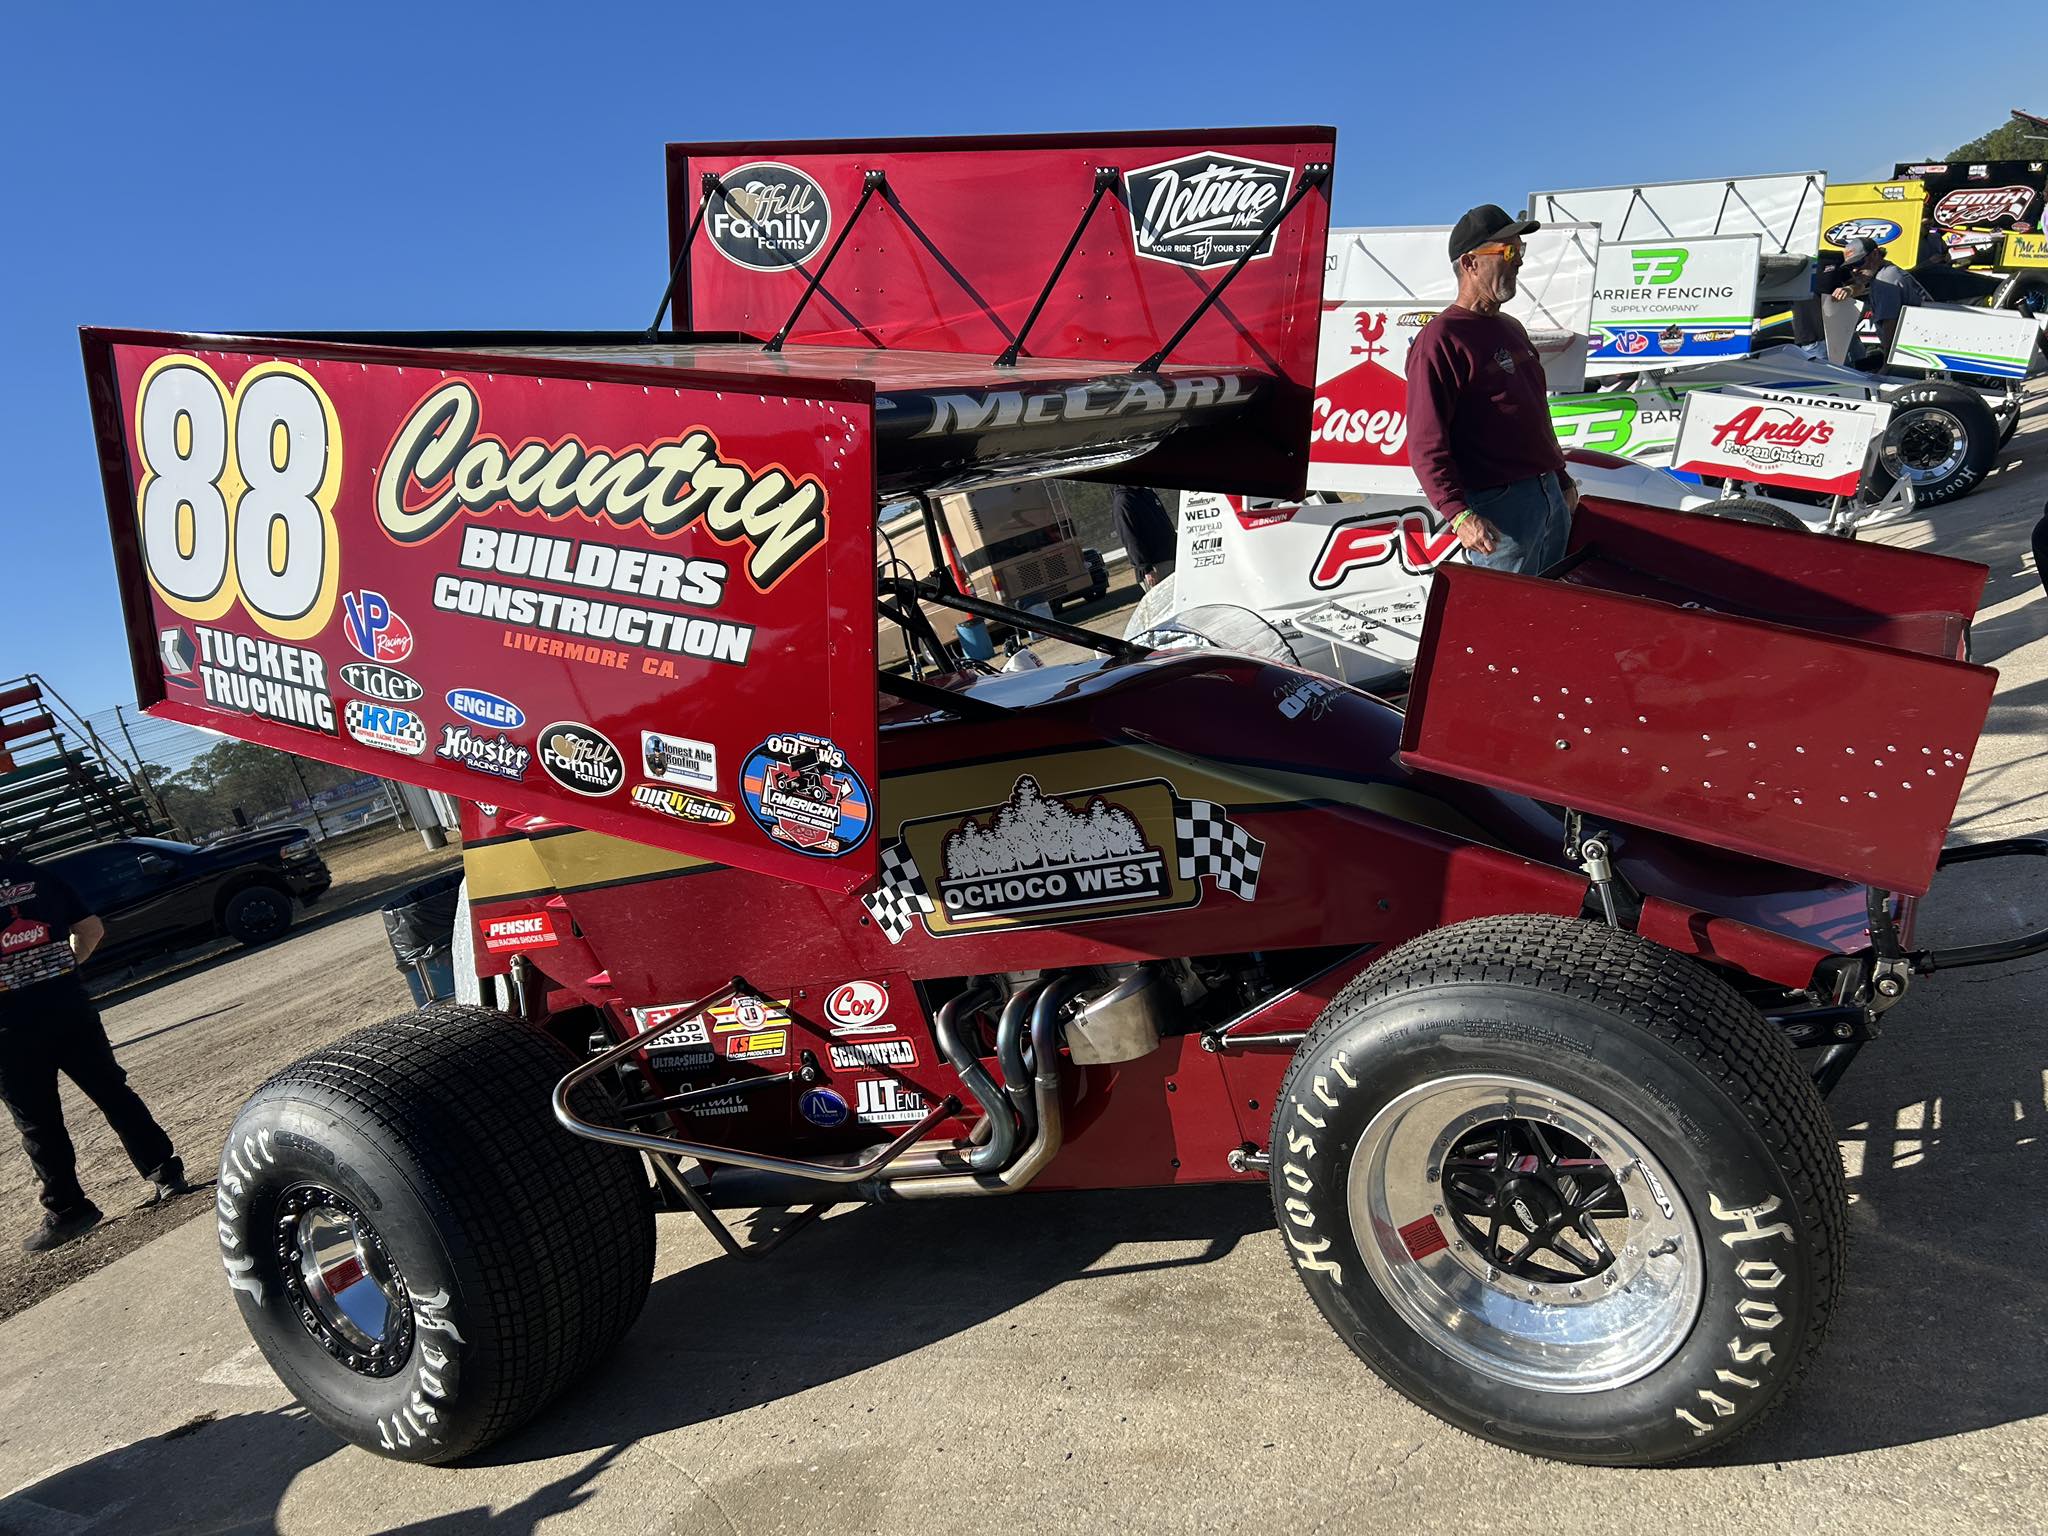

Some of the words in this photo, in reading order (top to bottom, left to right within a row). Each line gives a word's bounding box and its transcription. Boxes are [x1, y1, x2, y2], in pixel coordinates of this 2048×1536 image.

[1946, 188, 2023, 205] SMITH
[714, 214, 820, 244] Family
[1834, 224, 1893, 242] RSR
[758, 237, 805, 250] Farms
[1152, 244, 1173, 253] YOUR
[1175, 244, 1191, 252] RIDE
[1213, 244, 1234, 252] YOUR
[1236, 244, 1260, 252] STY
[2021, 240, 2035, 253] Mr.
[1657, 286, 1734, 299] FENCING
[1610, 305, 1648, 313] SUPPLY
[1649, 304, 1700, 313] COMPANY
[1711, 405, 1834, 447] Andy's
[1723, 440, 1770, 459] Frozen
[1770, 446, 1824, 467] Custard
[141, 363, 328, 621] 88
[376, 381, 823, 586] Country
[1185, 507, 1220, 521] WELD
[1258, 513, 1288, 526] BROWN
[1310, 505, 1464, 591] FV
[460, 526, 728, 605] BUILDERS
[343, 590, 390, 658] VP
[433, 576, 754, 664] CONSTRUCTION
[377, 627, 412, 654] Racing
[195, 626, 327, 690] TUCKER
[503, 631, 630, 671] LIVERMORE
[641, 657, 680, 680] CA.
[347, 666, 421, 699] rider
[199, 664, 336, 732] TRUCKING
[454, 692, 518, 725] ENGLER
[362, 704, 410, 736] HRP
[437, 726, 530, 769] Hoosier
[663, 742, 693, 758] Honest
[695, 748, 713, 762] Abe
[799, 735, 819, 744] WORLD
[467, 758, 499, 772] RACING
[501, 765, 519, 777] TIRE
[544, 749, 618, 784] Family
[666, 753, 700, 772] Roofing
[575, 770, 608, 786] Farms
[771, 791, 838, 820] AMERICAN
[776, 807, 797, 818] SPRINT
[797, 813, 811, 823] CAR
[811, 818, 832, 830] SERIES
[944, 874, 1067, 910] OCHOCO
[1076, 859, 1163, 892] WEST
[2, 924, 44, 948] Casey's
[490, 917, 543, 937] PENSKE
[498, 936, 520, 946] RACING
[520, 934, 544, 944] SHOCKS
[834, 986, 875, 1016] Cox
[649, 1033, 704, 1047] ENDS
[666, 1023, 700, 1036] OD
[1380, 1027, 1410, 1044] SAFETY
[830, 1041, 915, 1068] SCHOENFELD
[857, 1080, 899, 1113] JLT
[693, 1104, 749, 1117] TITANIUM
[1281, 1049, 1359, 1287] Hoosier
[1675, 1189, 1798, 1438] Hoosier
